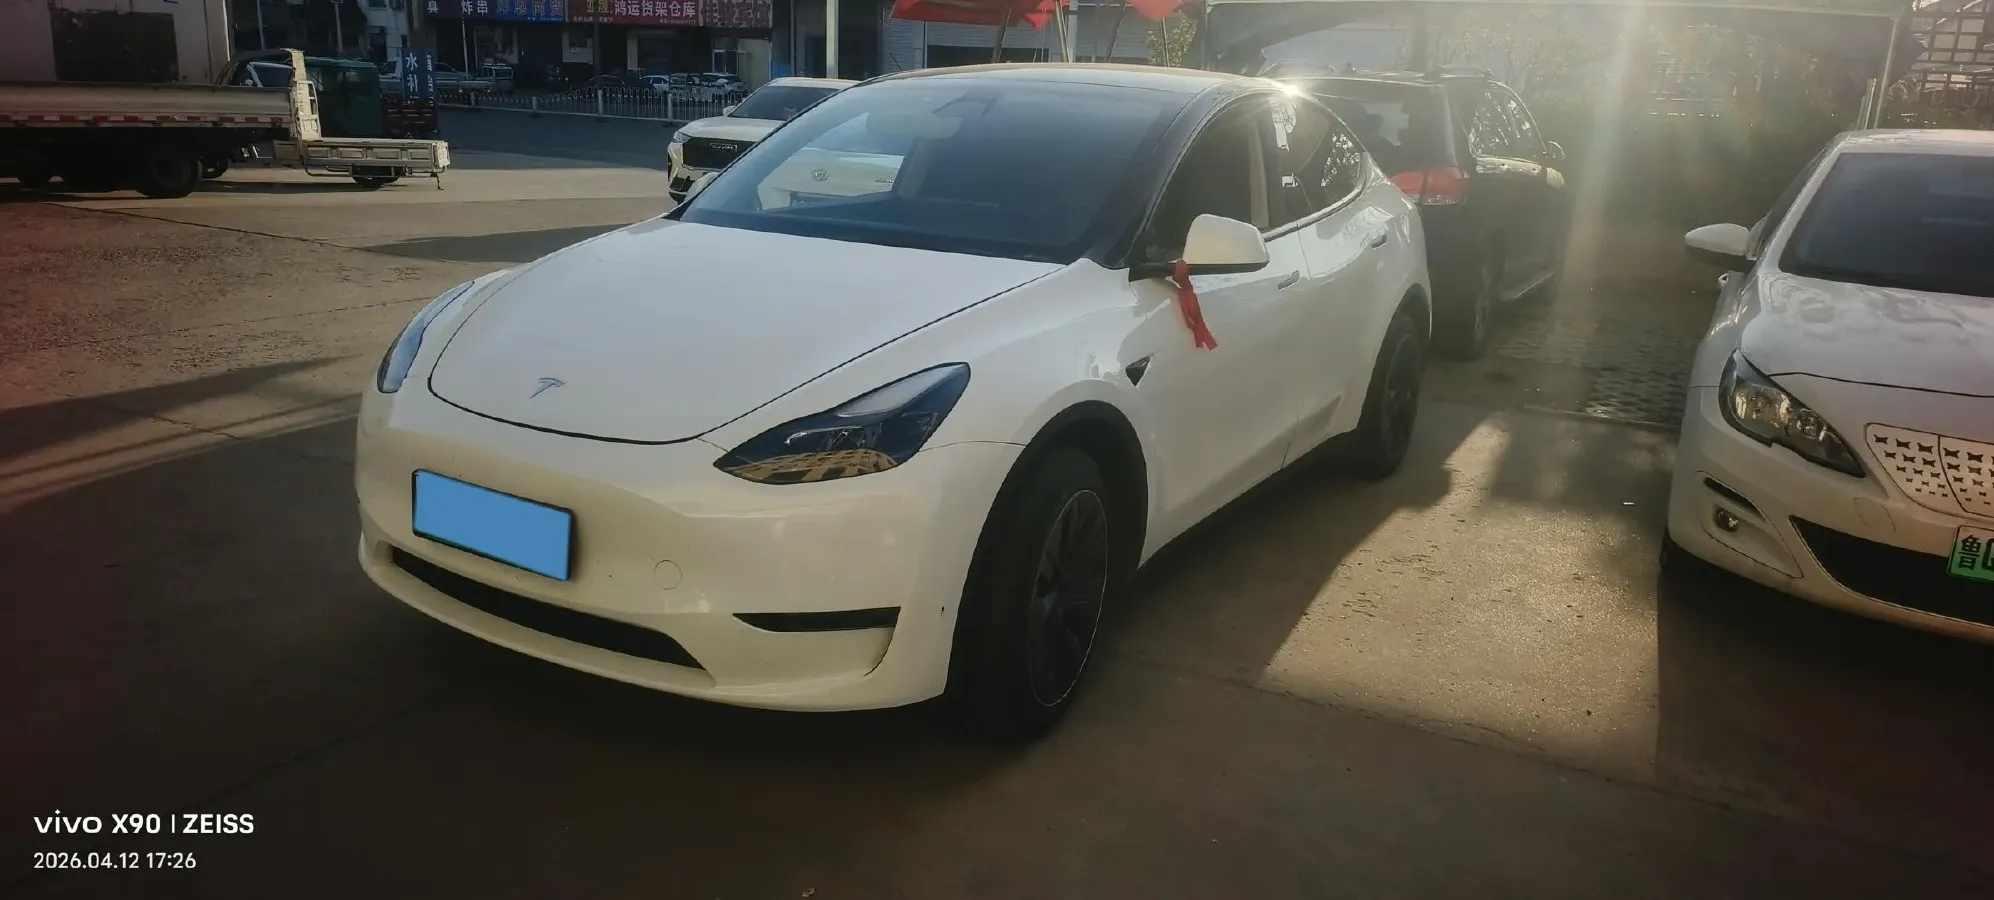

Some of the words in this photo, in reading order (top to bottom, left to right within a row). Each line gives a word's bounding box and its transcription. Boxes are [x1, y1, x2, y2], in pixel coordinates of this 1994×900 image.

[461, 0, 488, 15] 炸串
[614, 0, 696, 17] 鸿运货架仓库
